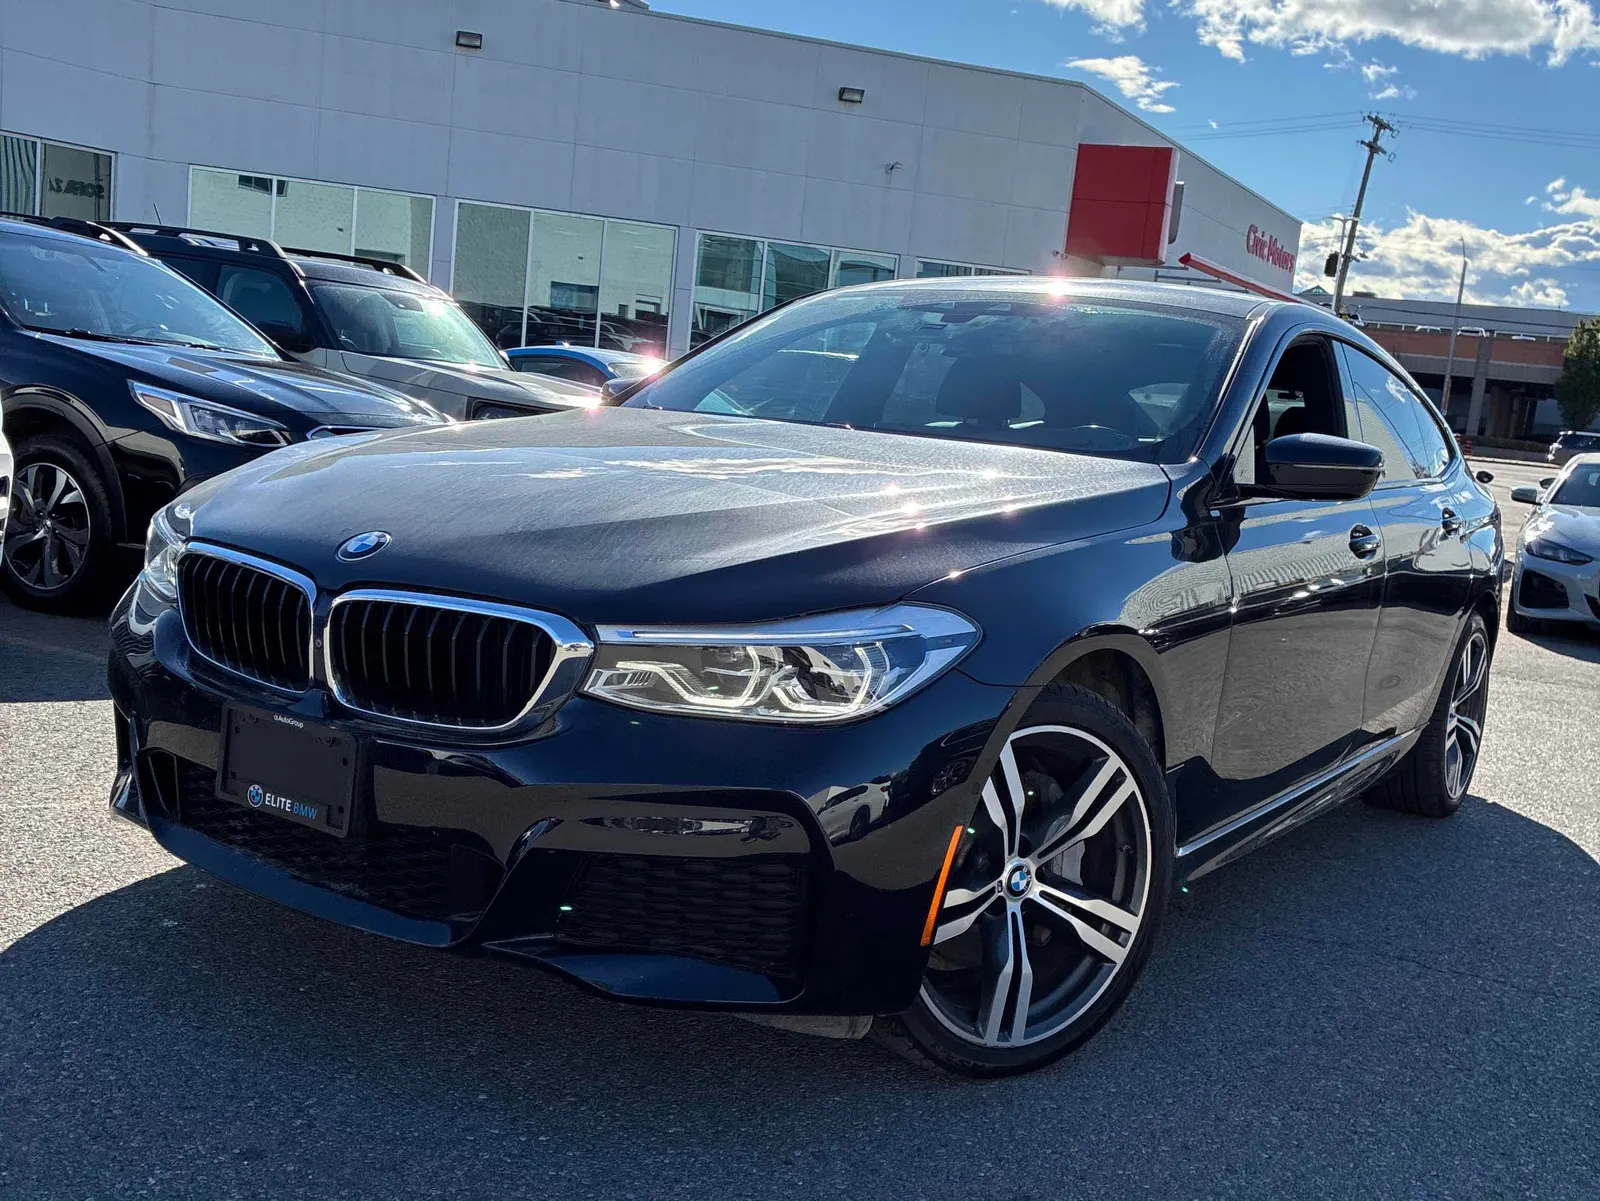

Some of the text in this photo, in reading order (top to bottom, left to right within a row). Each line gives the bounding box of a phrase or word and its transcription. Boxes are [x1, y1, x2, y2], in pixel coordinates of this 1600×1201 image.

[1246, 224, 1296, 273] Civic Motors
[265, 793, 318, 820] ELITE BMW
